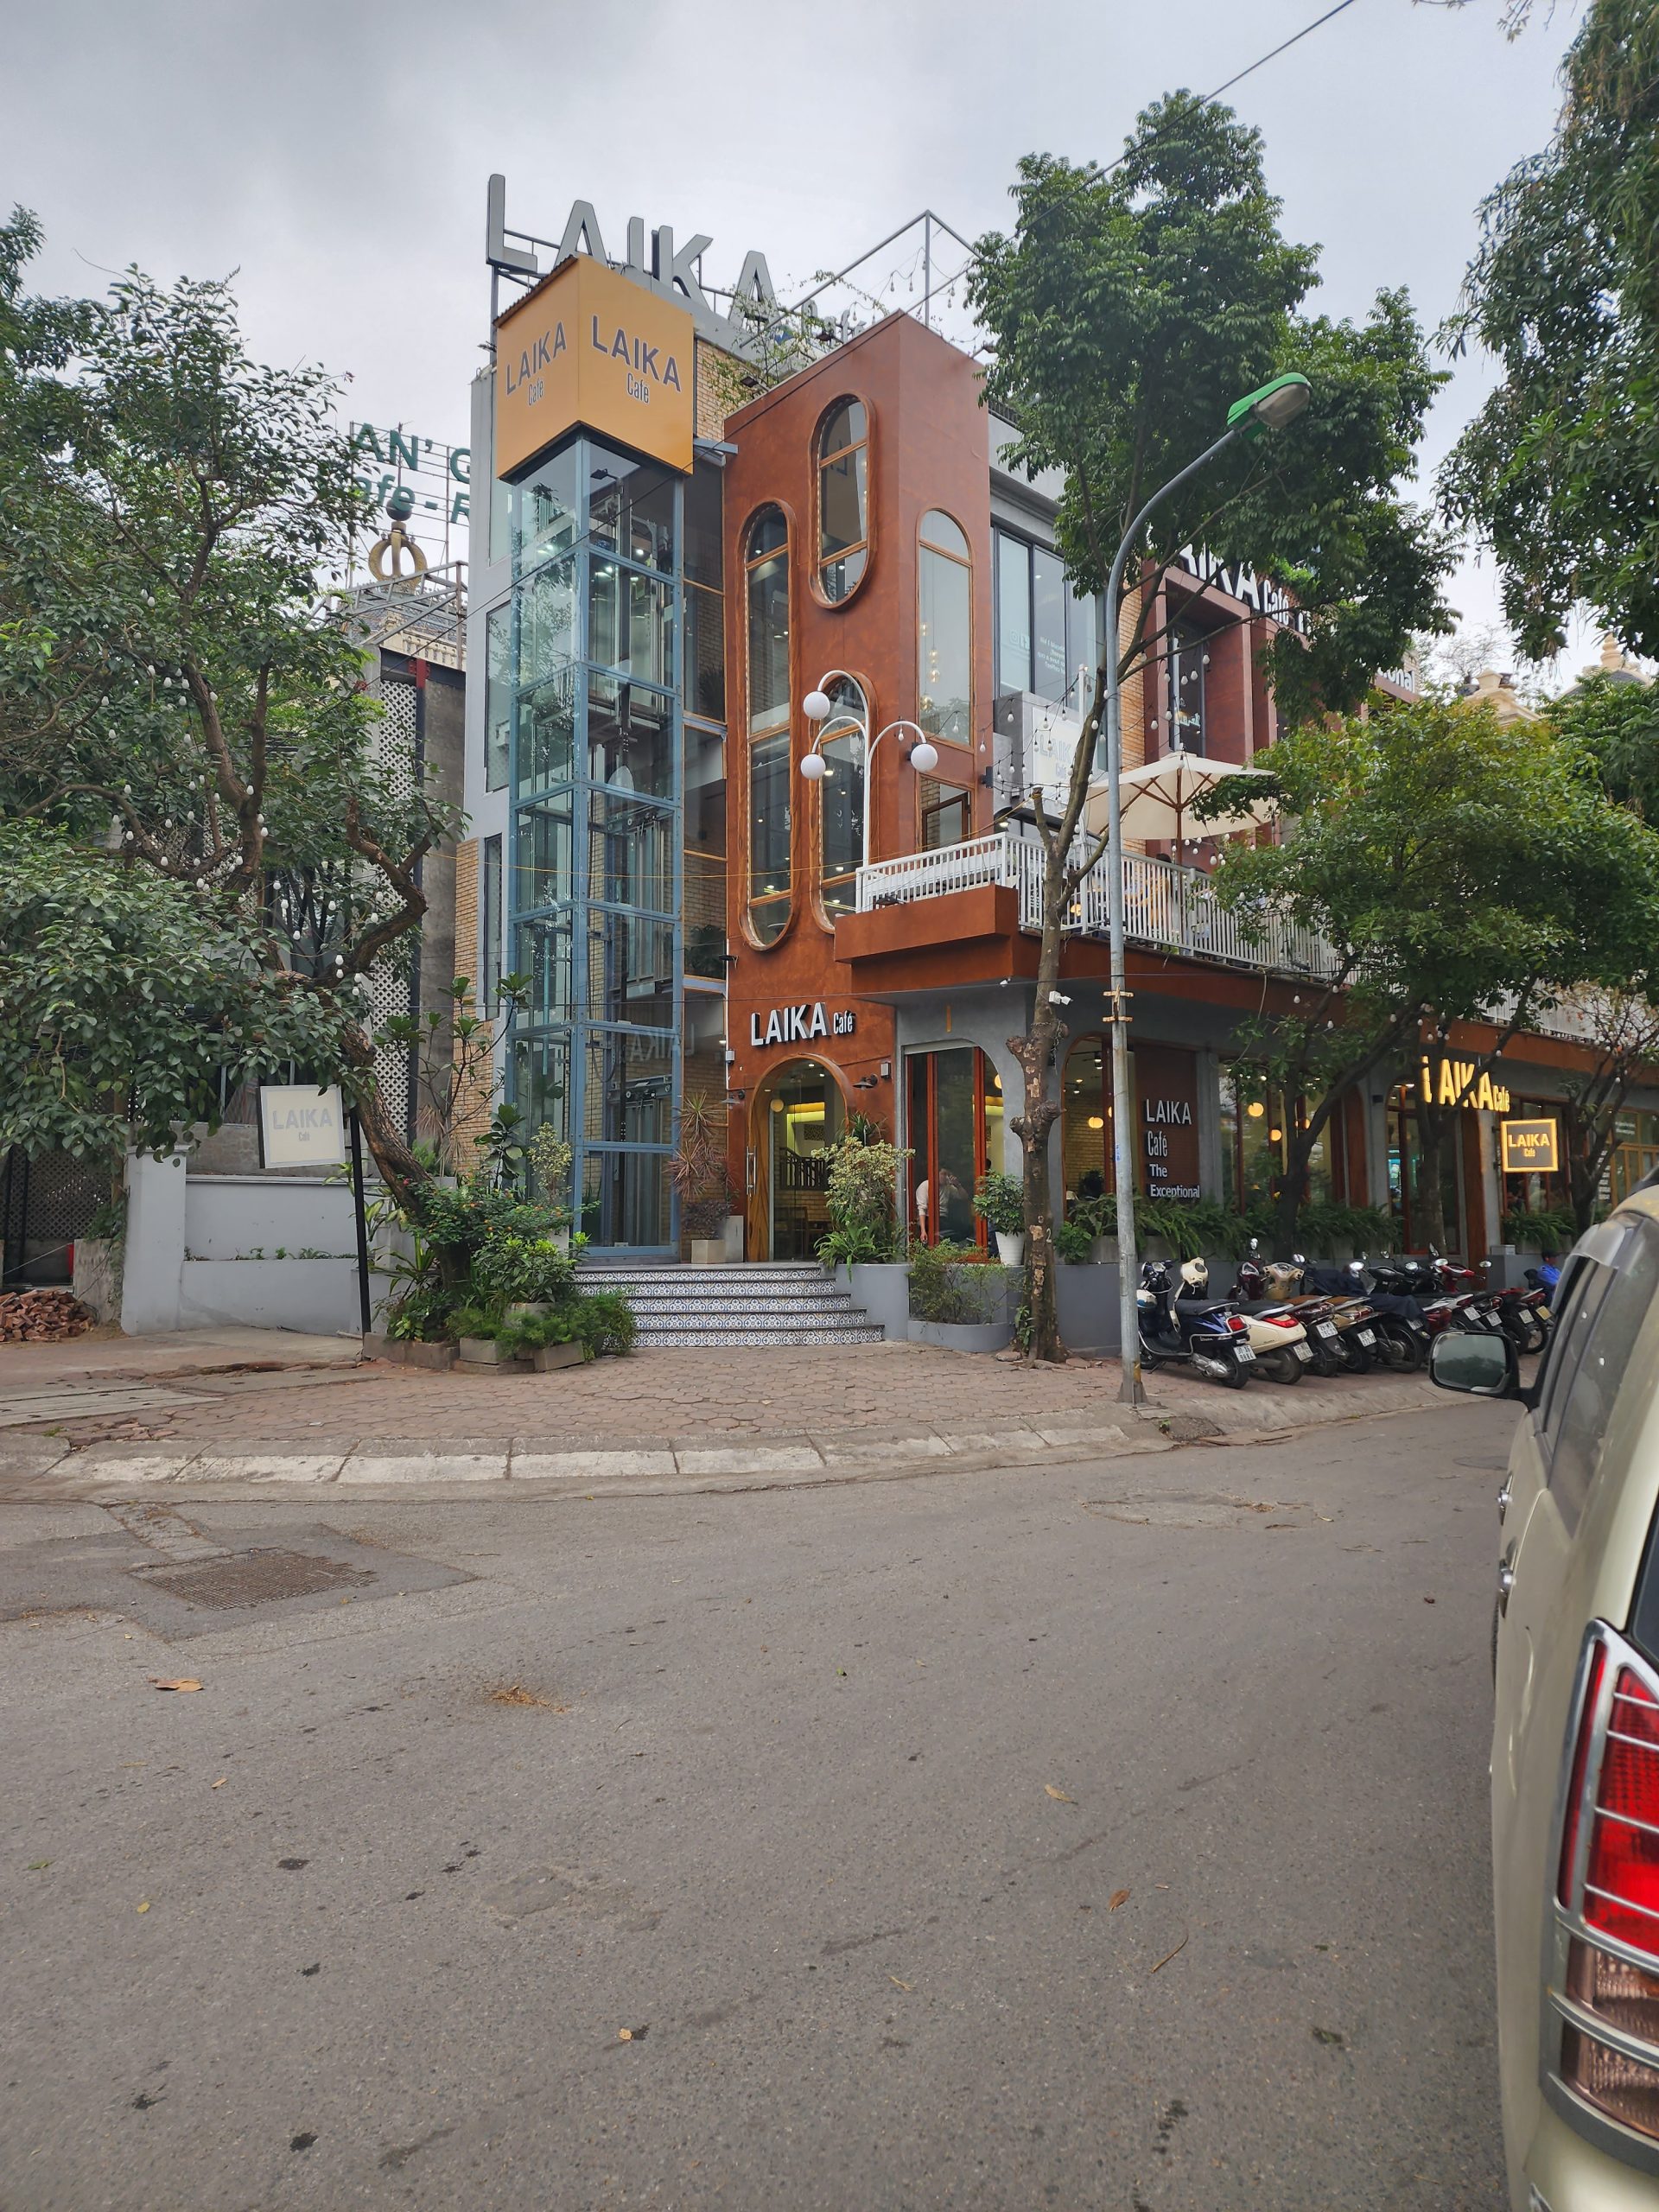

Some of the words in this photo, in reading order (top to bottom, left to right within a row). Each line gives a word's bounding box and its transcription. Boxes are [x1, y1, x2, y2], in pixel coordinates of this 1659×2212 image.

[486, 174, 780, 334] LAIKA
[505, 321, 567, 397] LAIKA
[593, 315, 682, 392] LAIKA
[528, 377, 543, 408] Café
[626, 372, 650, 404] Café
[752, 1001, 830, 1047] LAIKA
[833, 1012, 855, 1034] Café
[272, 1108, 333, 1130] LAIKA
[1146, 1098, 1192, 1125] LAIKA
[1147, 1130, 1168, 1157] Café
[1508, 1133, 1551, 1148] LAIKA
[1149, 1163, 1168, 1177] The
[1150, 1184, 1200, 1198] Exceptional
